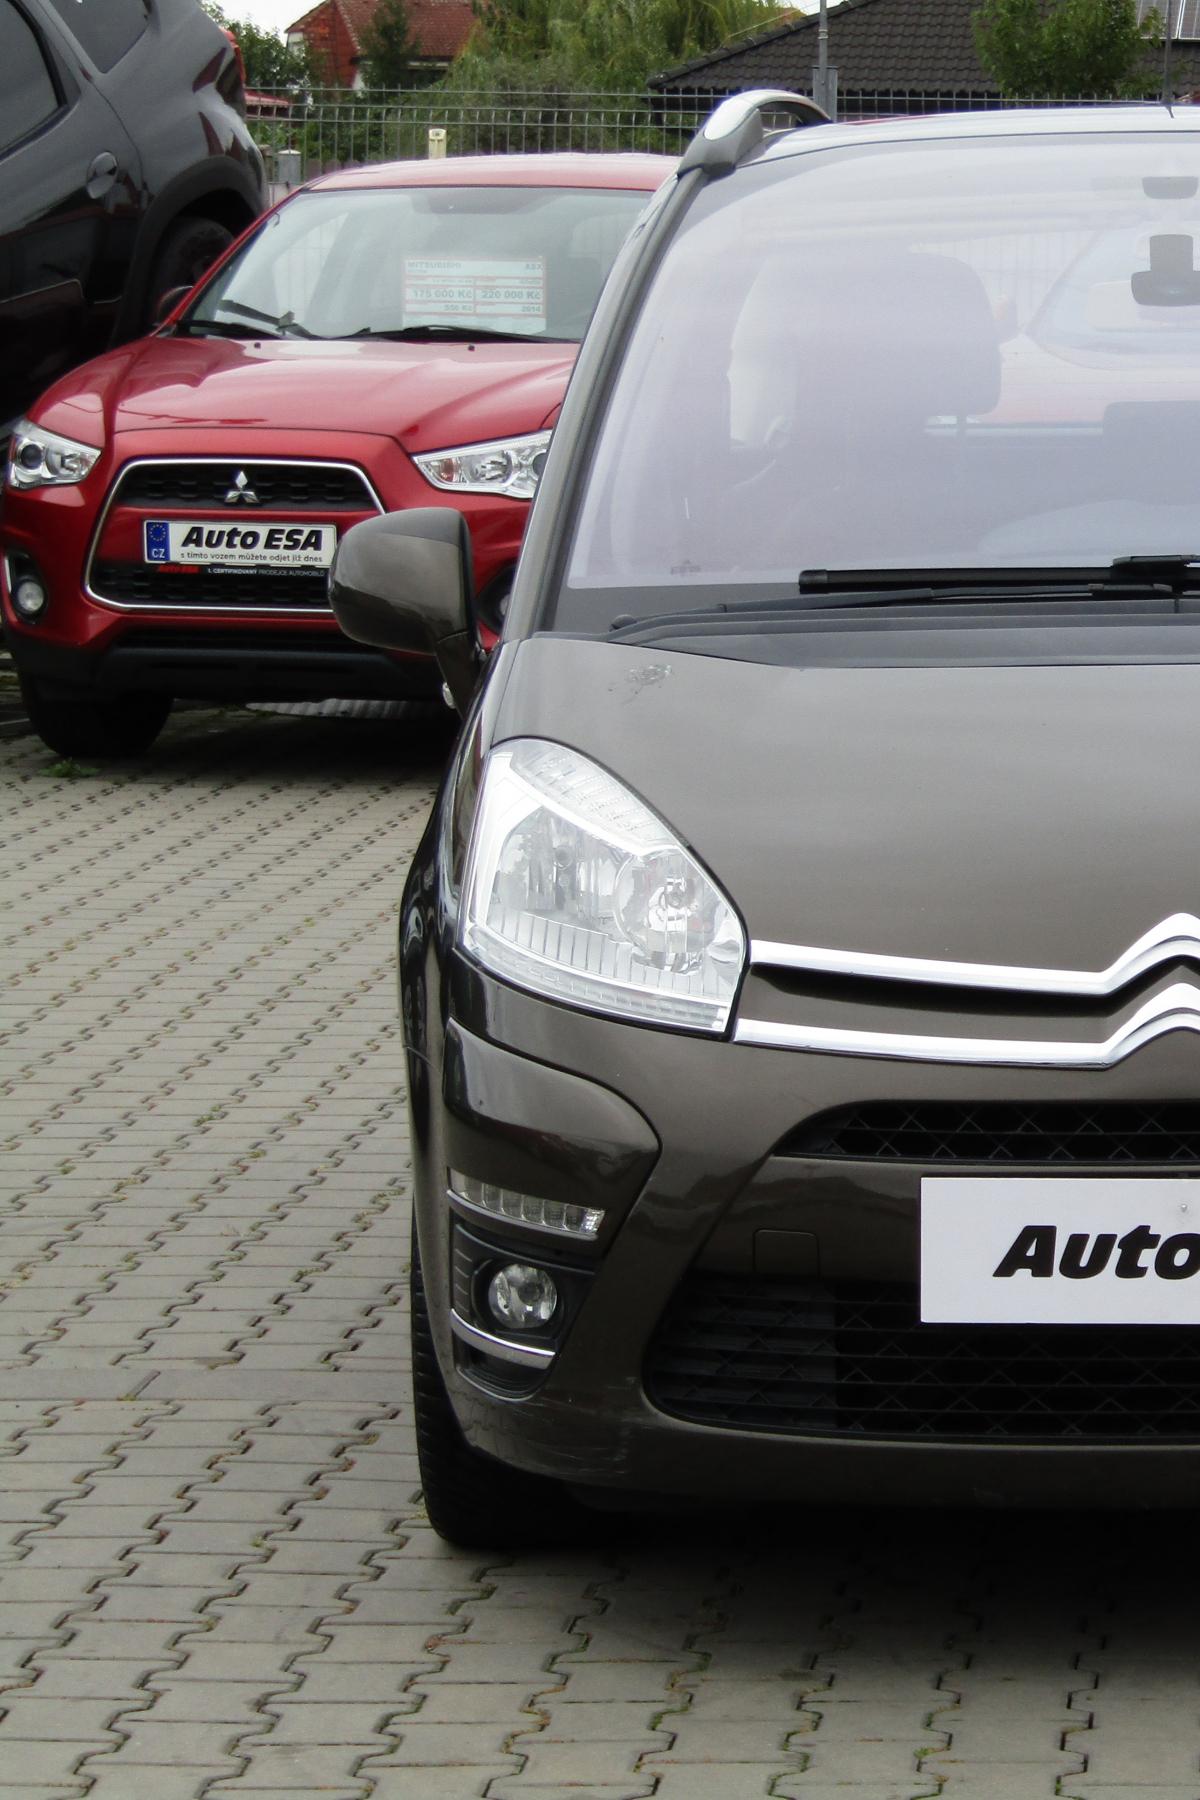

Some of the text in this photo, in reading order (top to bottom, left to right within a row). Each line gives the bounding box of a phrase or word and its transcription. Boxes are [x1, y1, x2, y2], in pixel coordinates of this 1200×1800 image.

[413, 288, 472, 298] 175 000 Kč
[481, 290, 541, 300] 220 000 Kč
[181, 526, 323, 551] Auto ESA
[152, 548, 166, 559] CZ
[269, 553, 290, 562] odjet
[304, 554, 323, 563] dnes
